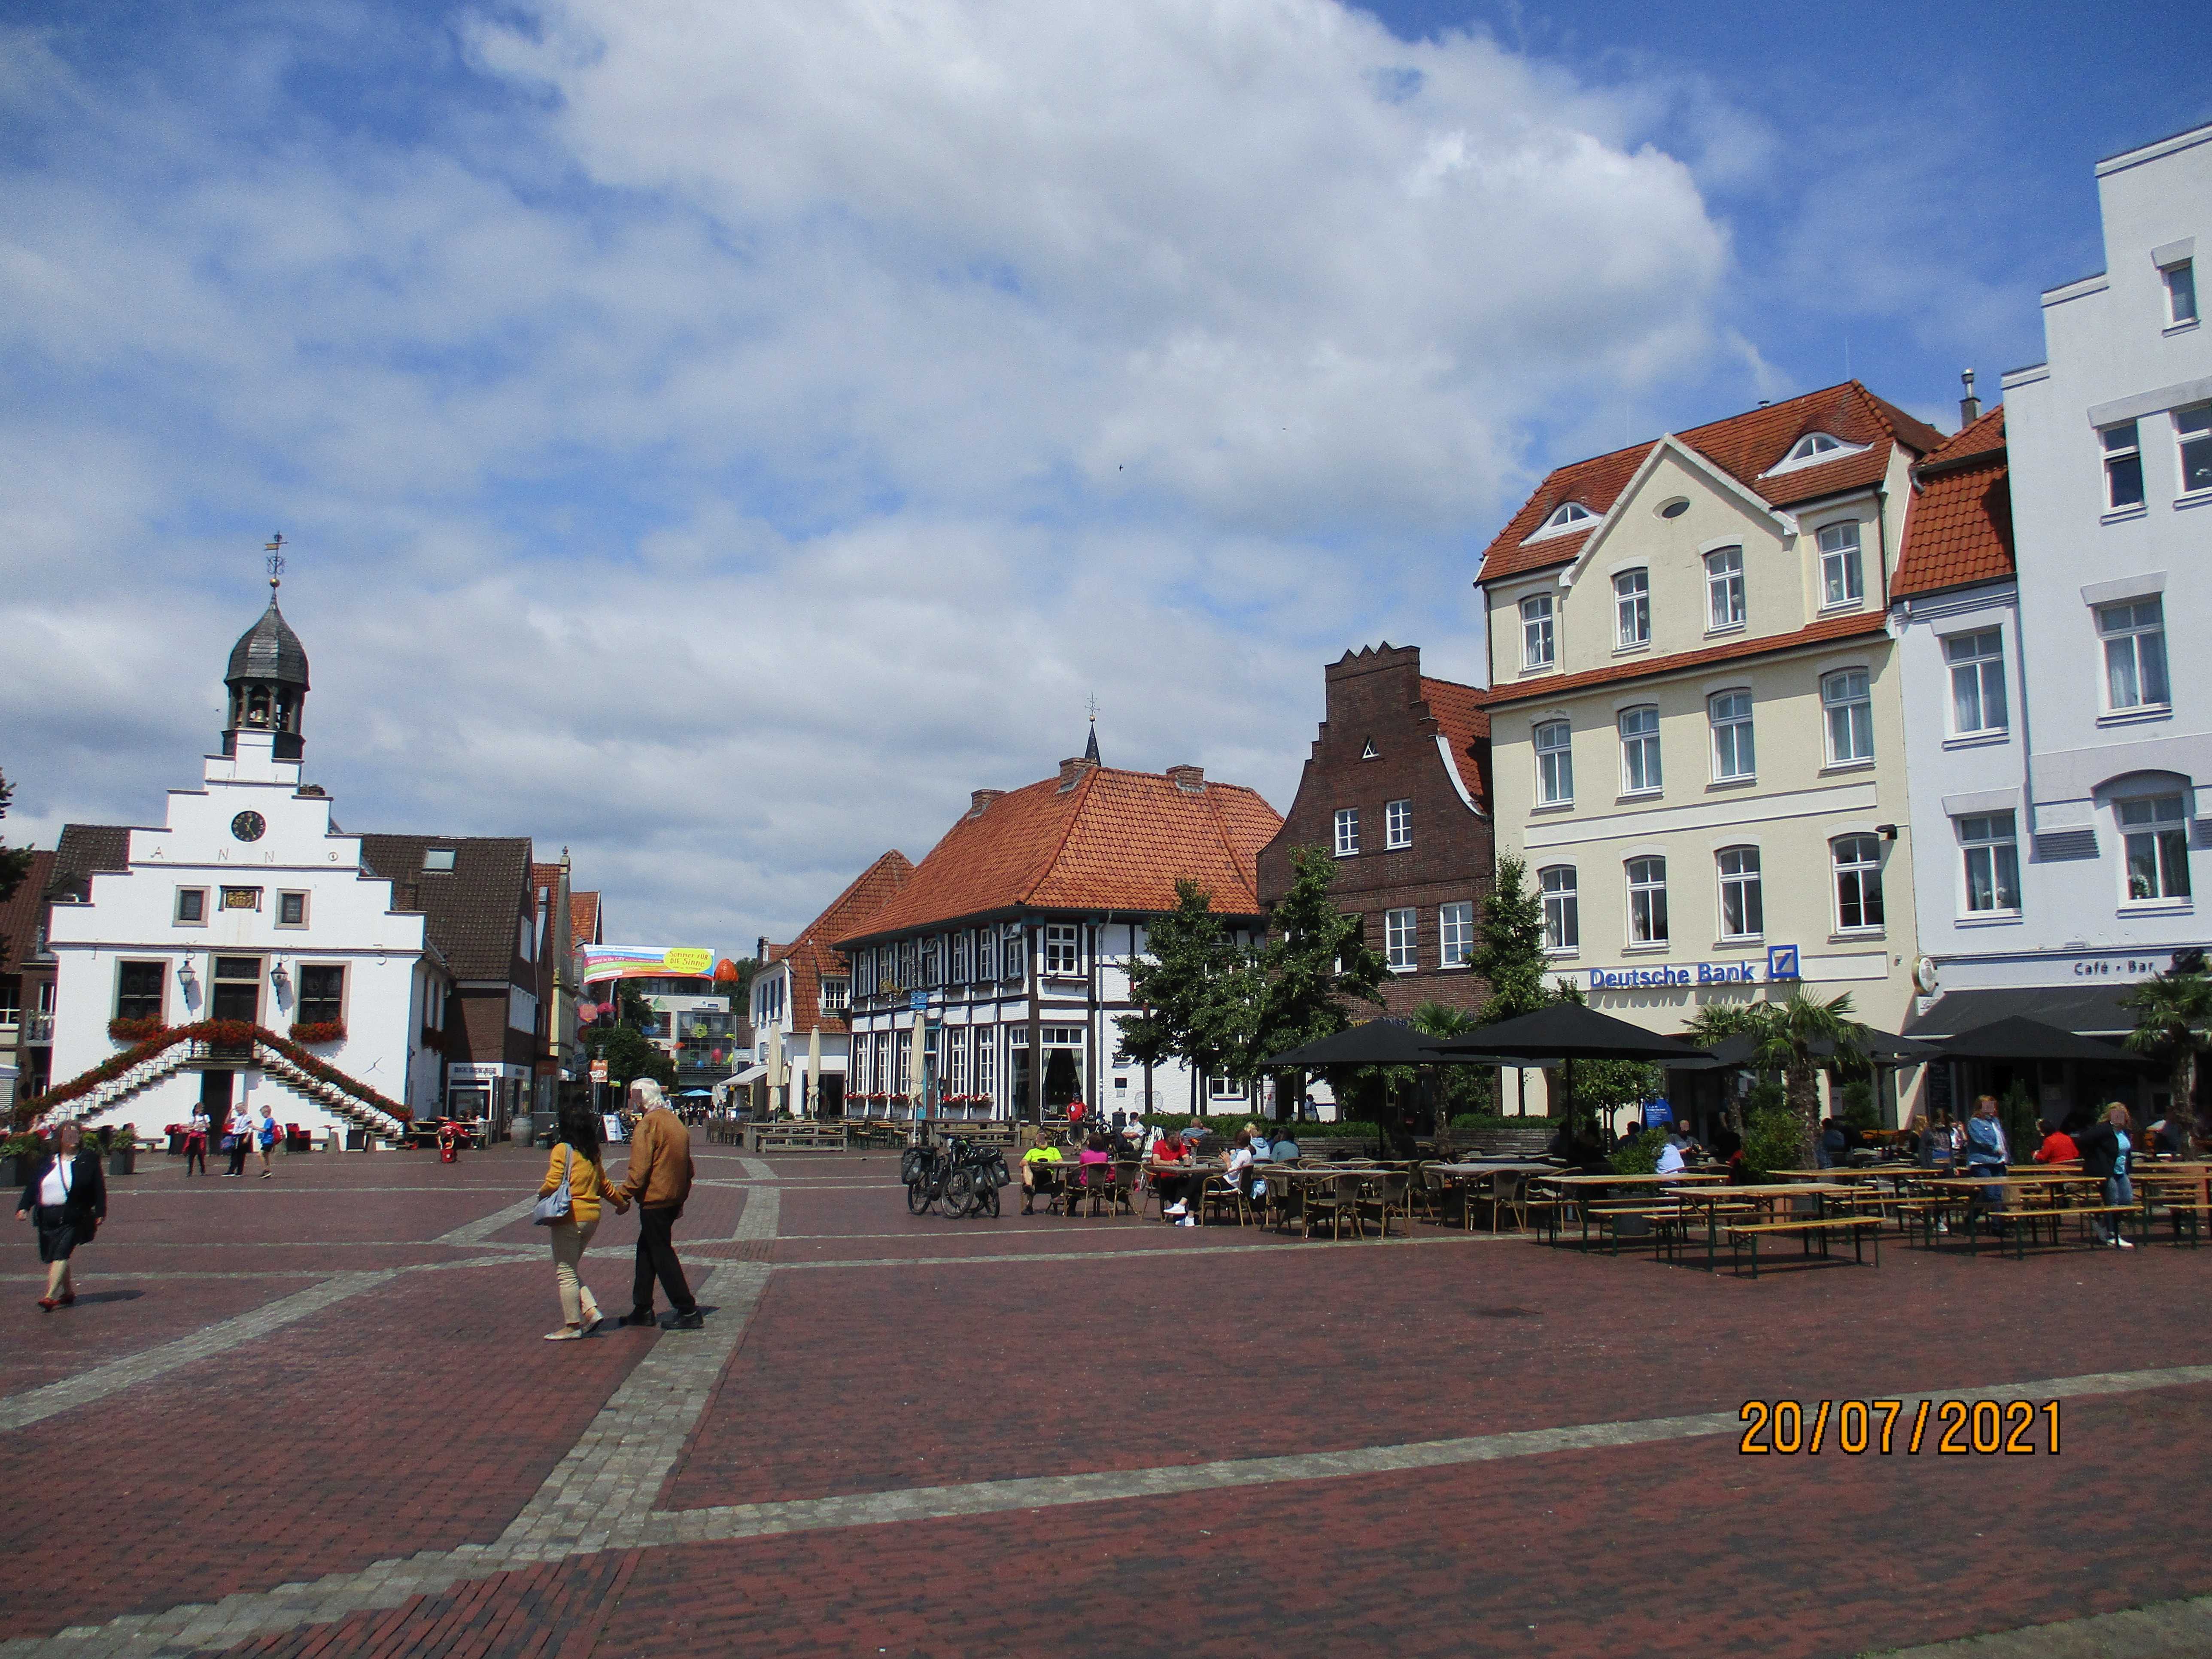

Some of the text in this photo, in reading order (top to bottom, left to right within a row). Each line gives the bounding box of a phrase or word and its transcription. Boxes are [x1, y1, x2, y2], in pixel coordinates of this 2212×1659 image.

[683, 958, 705, 967] Sinne
[2074, 960, 2153, 976] Café Bar
[1590, 960, 1755, 987] Deutsche Bank
